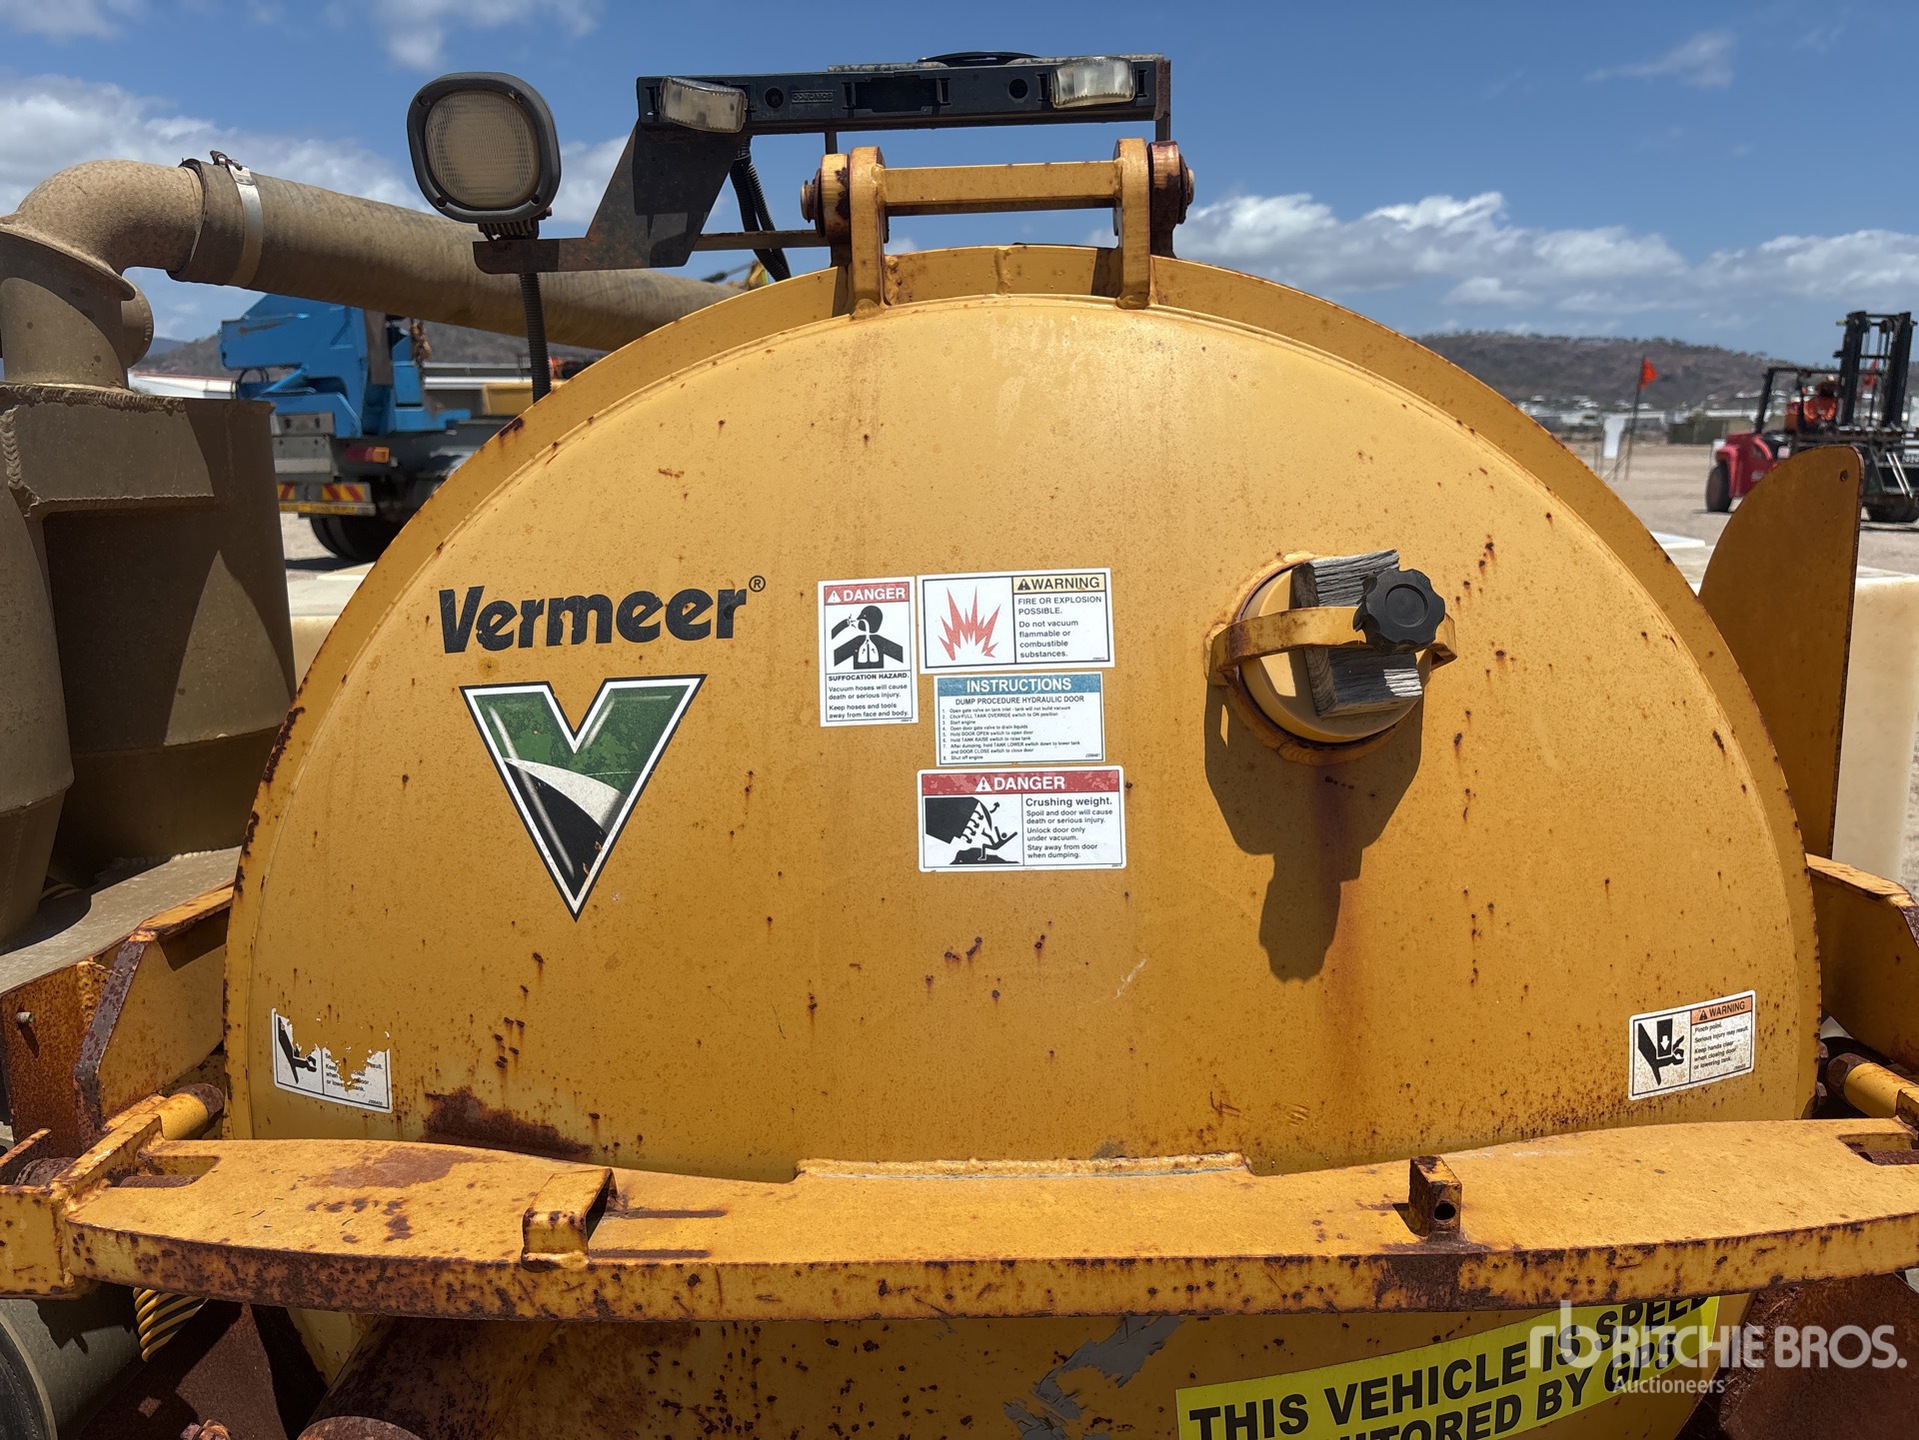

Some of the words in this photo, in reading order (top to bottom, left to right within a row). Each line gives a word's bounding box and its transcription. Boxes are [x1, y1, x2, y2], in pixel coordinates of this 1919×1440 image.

[1031, 577, 1100, 590] WARNING
[844, 588, 906, 602] DANGER
[967, 678, 1072, 692] INSTRUCTIONS
[994, 777, 1065, 790] DANGER
[1026, 798, 1073, 808] Crushing
[1076, 797, 1112, 806] weight.
[1709, 1001, 1745, 1017] WARNING
[1189, 1393, 1308, 1440] THIS
[1324, 1341, 1528, 1426] VEHICLE
[1542, 1323, 1580, 1373] IS
[1594, 1297, 1708, 1351] SPEE
[1536, 1366, 1592, 1420] BY
[1604, 1329, 1678, 1392] GPS
